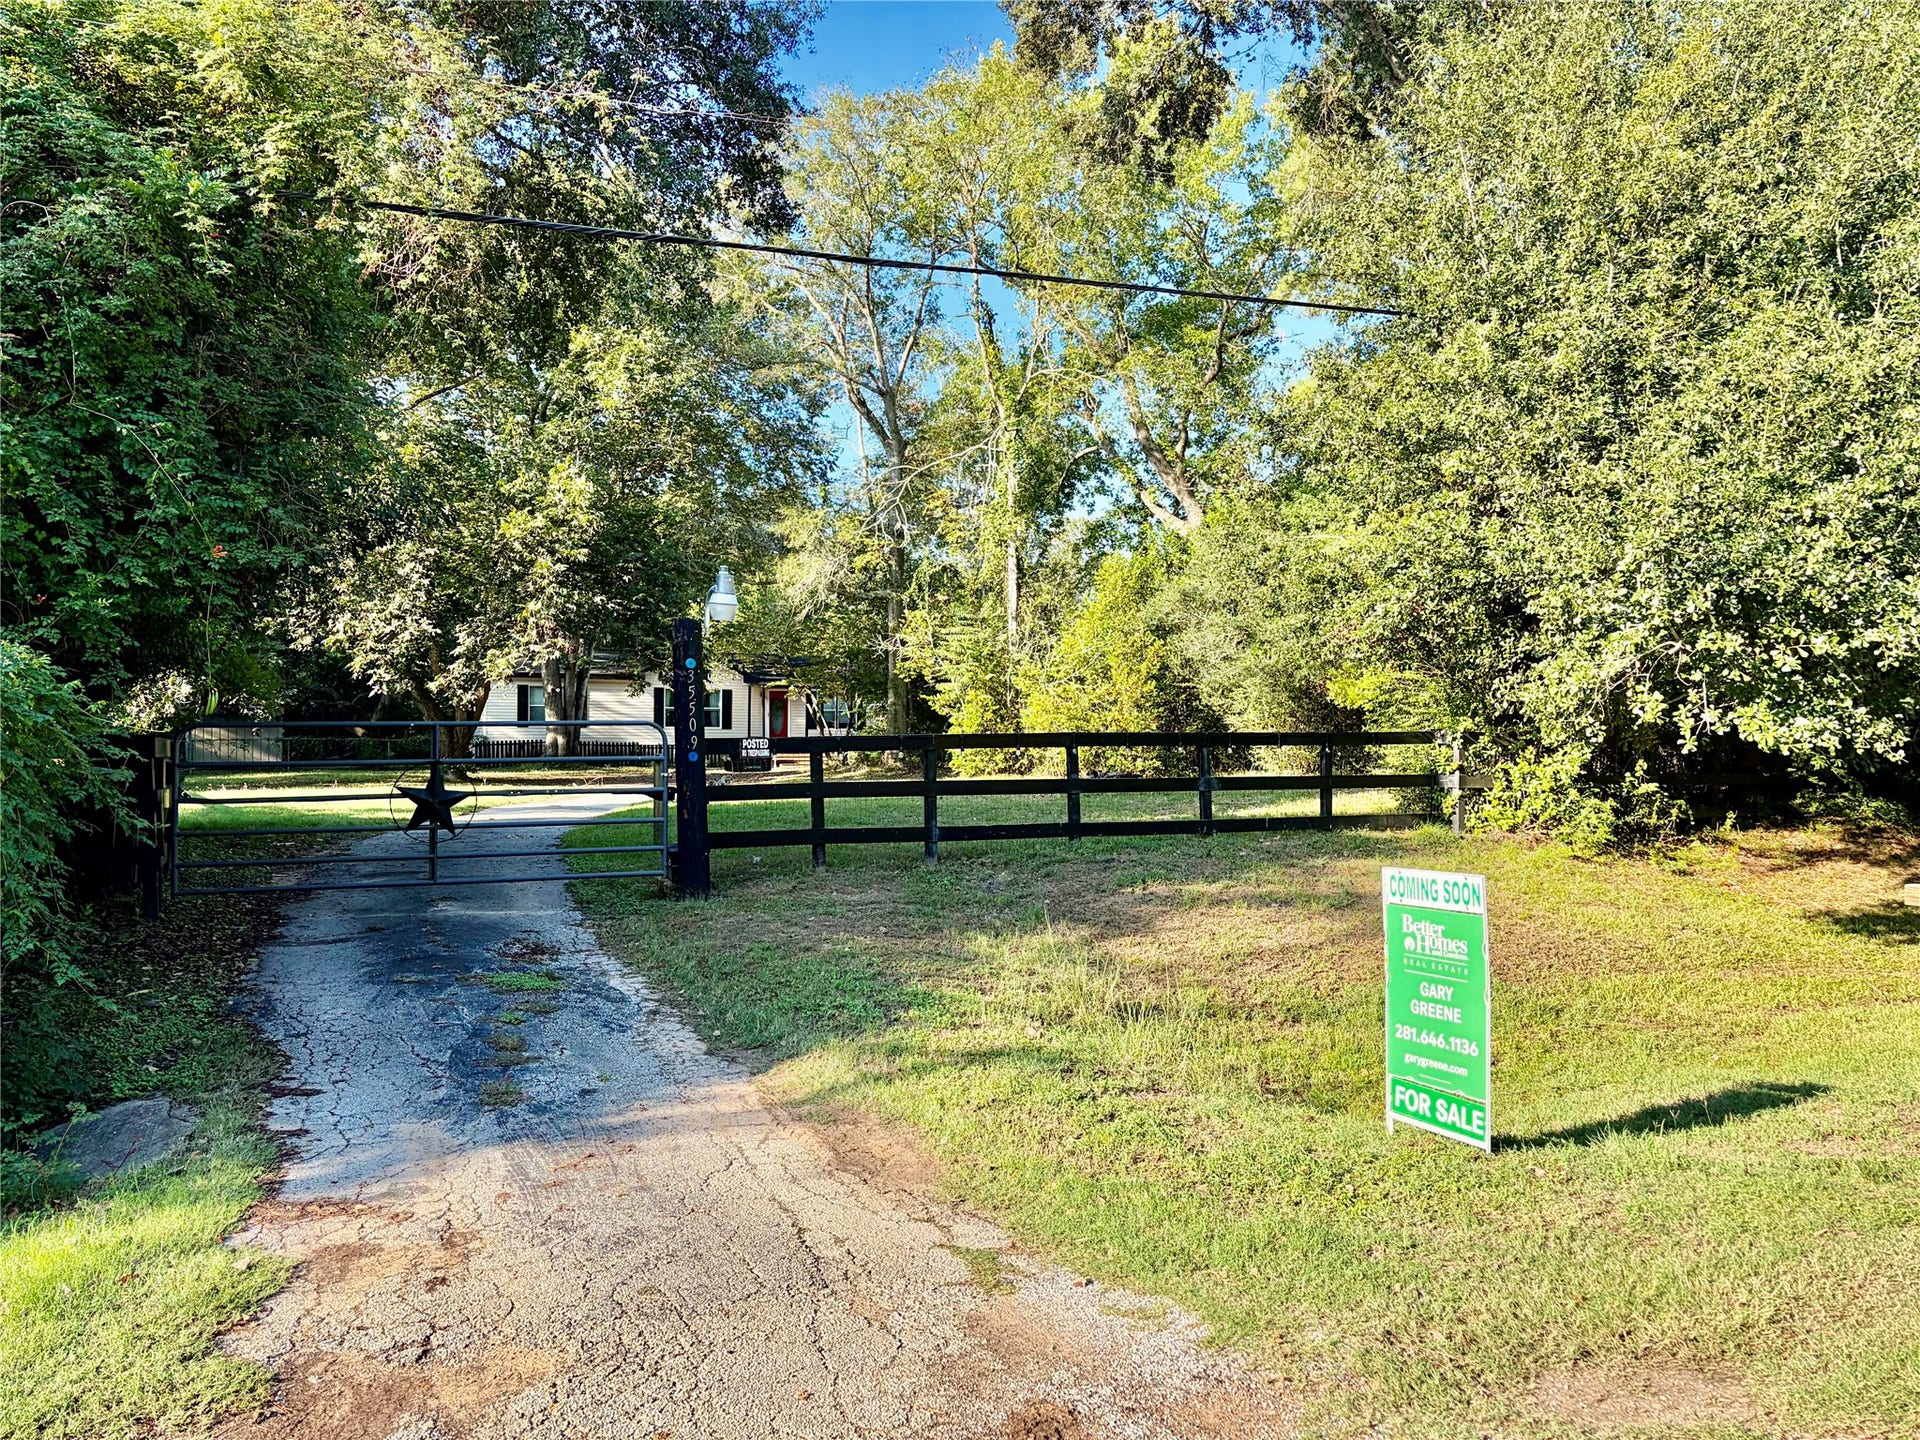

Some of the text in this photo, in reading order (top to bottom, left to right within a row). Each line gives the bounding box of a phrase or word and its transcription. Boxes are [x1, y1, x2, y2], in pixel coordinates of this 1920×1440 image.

[687, 669, 698, 750] 35509
[742, 738, 769, 749] POSTED
[1389, 874, 1481, 907] COMING SOON
[1402, 914, 1445, 938] Better
[1416, 935, 1469, 954] Homes
[1403, 957, 1469, 976] REAL ESTATE
[1419, 981, 1454, 1002] GARY
[1410, 999, 1462, 1024] GREENE
[1395, 1023, 1479, 1057] 281.646.1136
[1404, 1053, 1468, 1077] garygreene.com
[1395, 1085, 1485, 1136] FOR SALE
